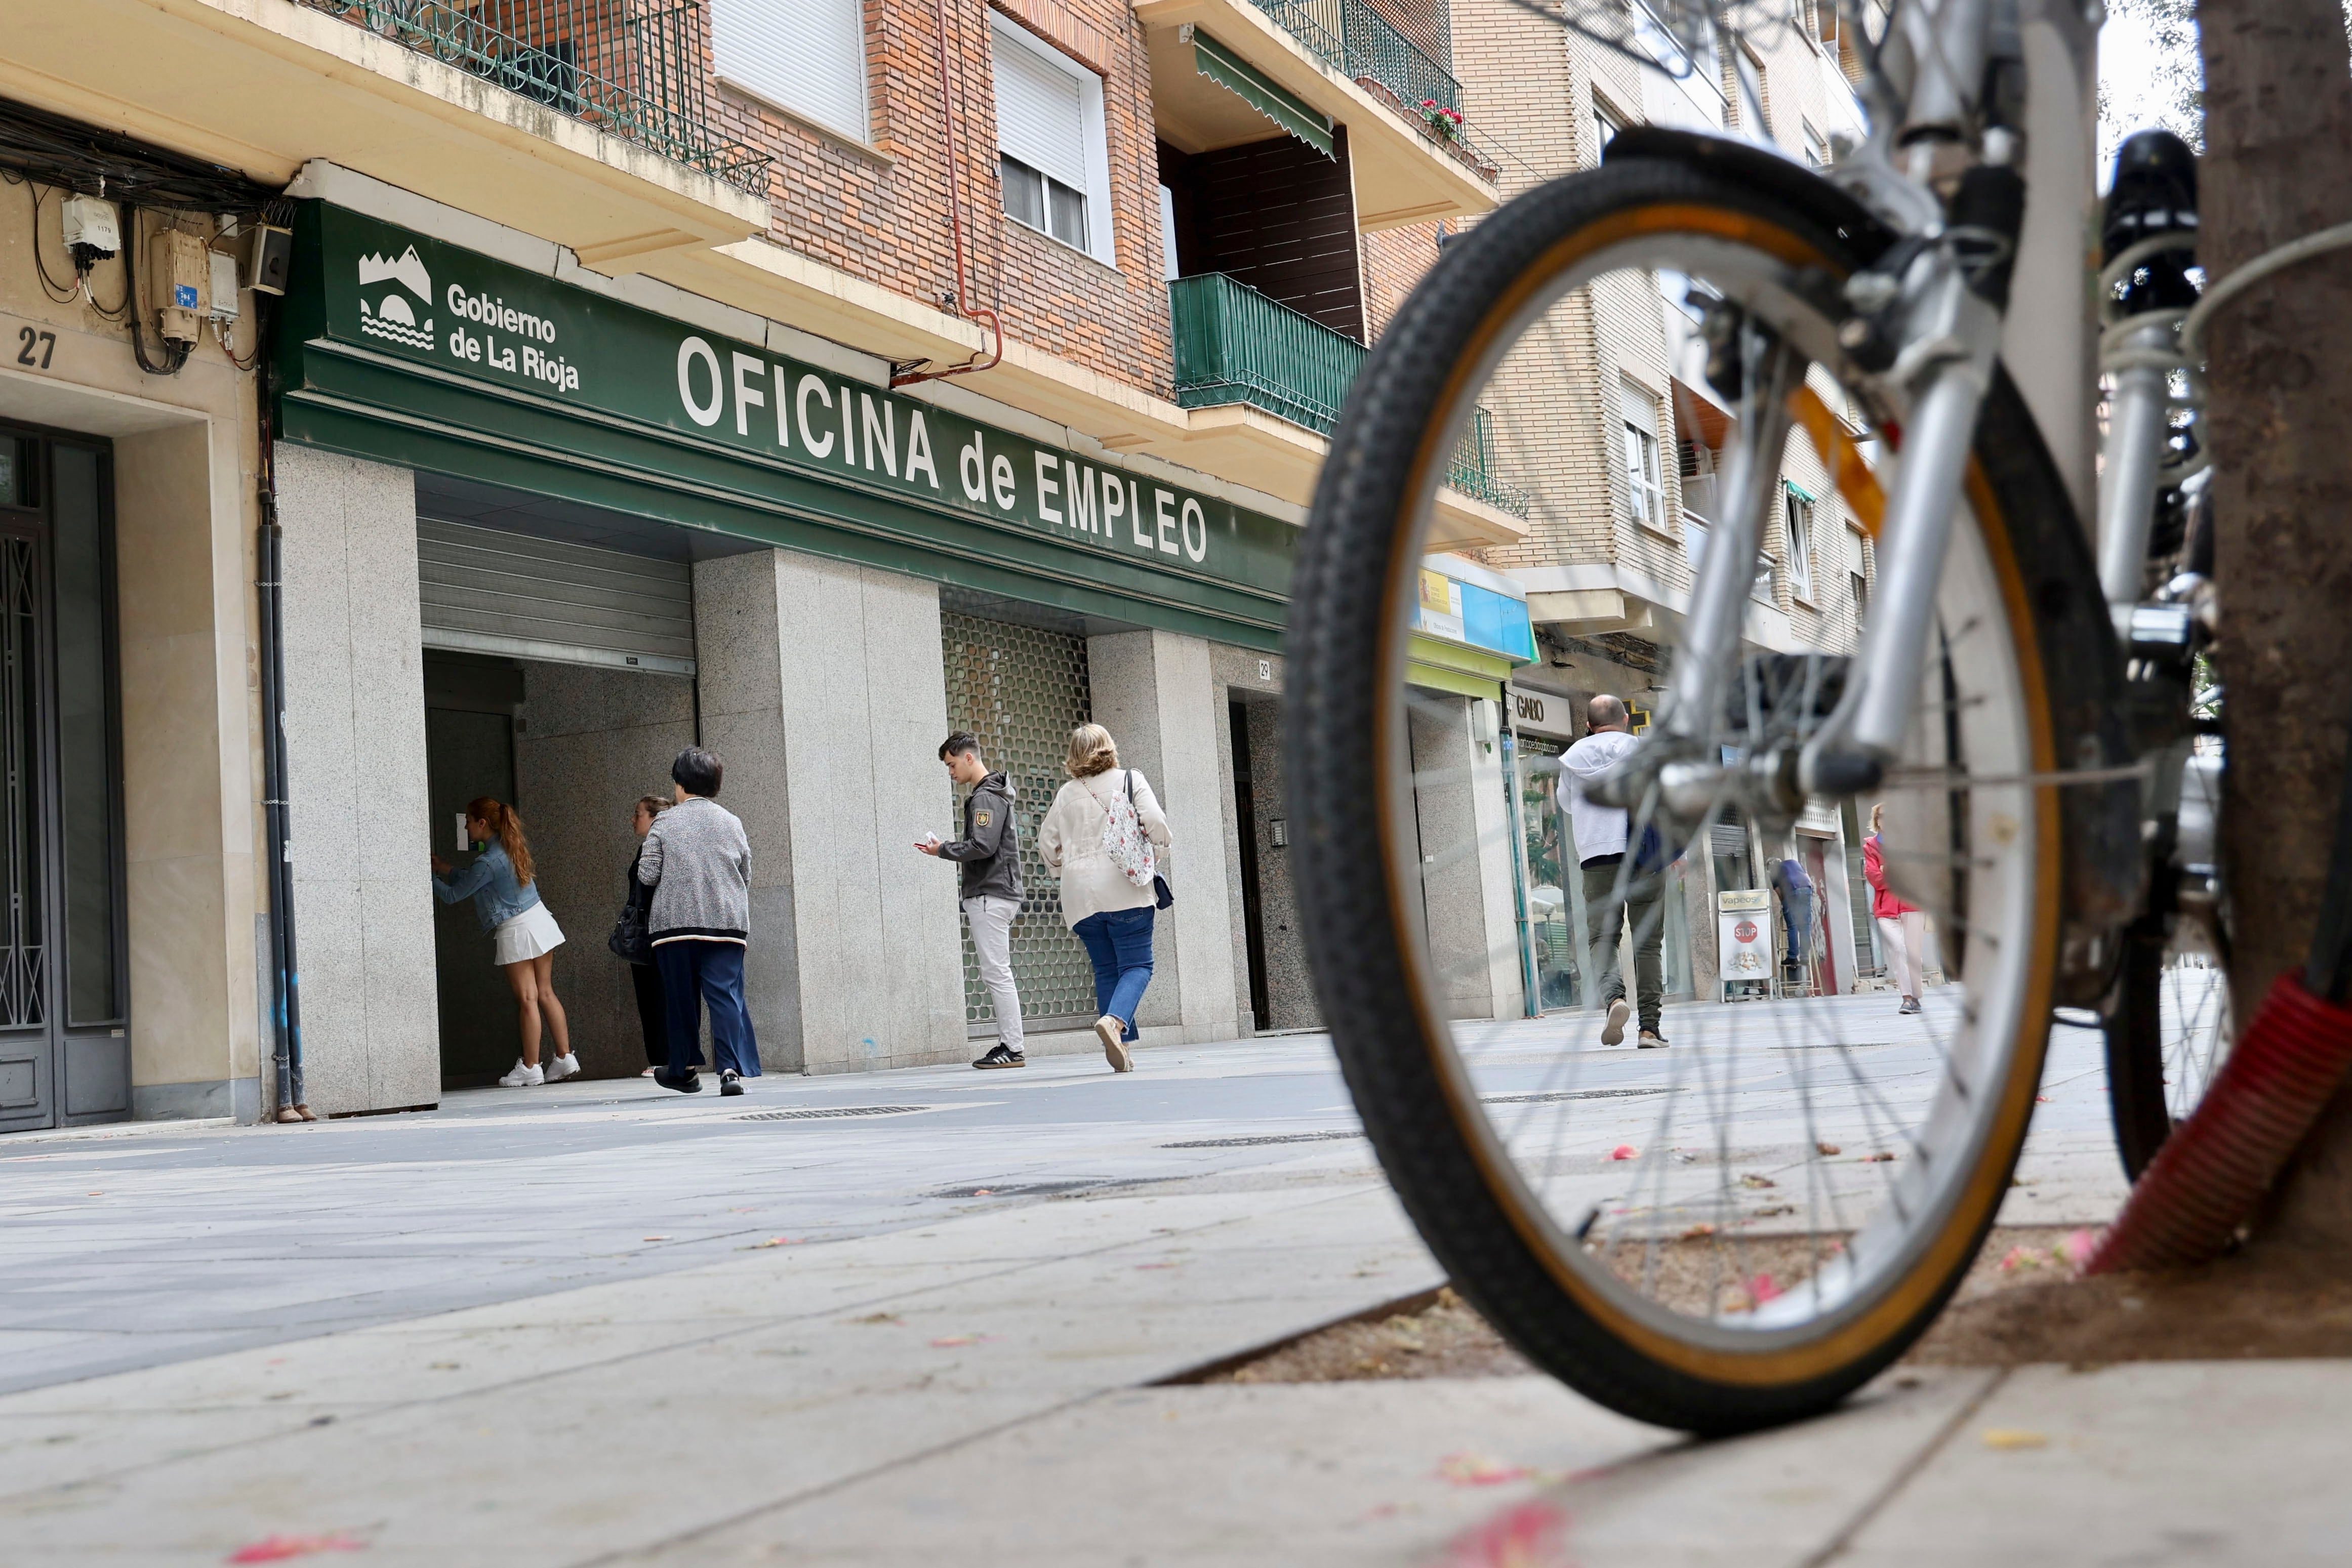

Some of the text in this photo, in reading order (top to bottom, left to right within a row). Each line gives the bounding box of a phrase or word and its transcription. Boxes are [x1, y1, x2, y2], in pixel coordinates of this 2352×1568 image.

[97, 225, 111, 233] 1179
[447, 283, 556, 344] Gobierno
[18, 326, 56, 369] 27
[450, 326, 579, 392] de La Rioja
[677, 336, 1207, 563] OFICINA de EMPLEO
[1261, 663, 1268, 676] 29
[1516, 694, 1545, 722] GABO
[1722, 896, 1756, 905] vapeos
[1735, 927, 1757, 937] STOP
